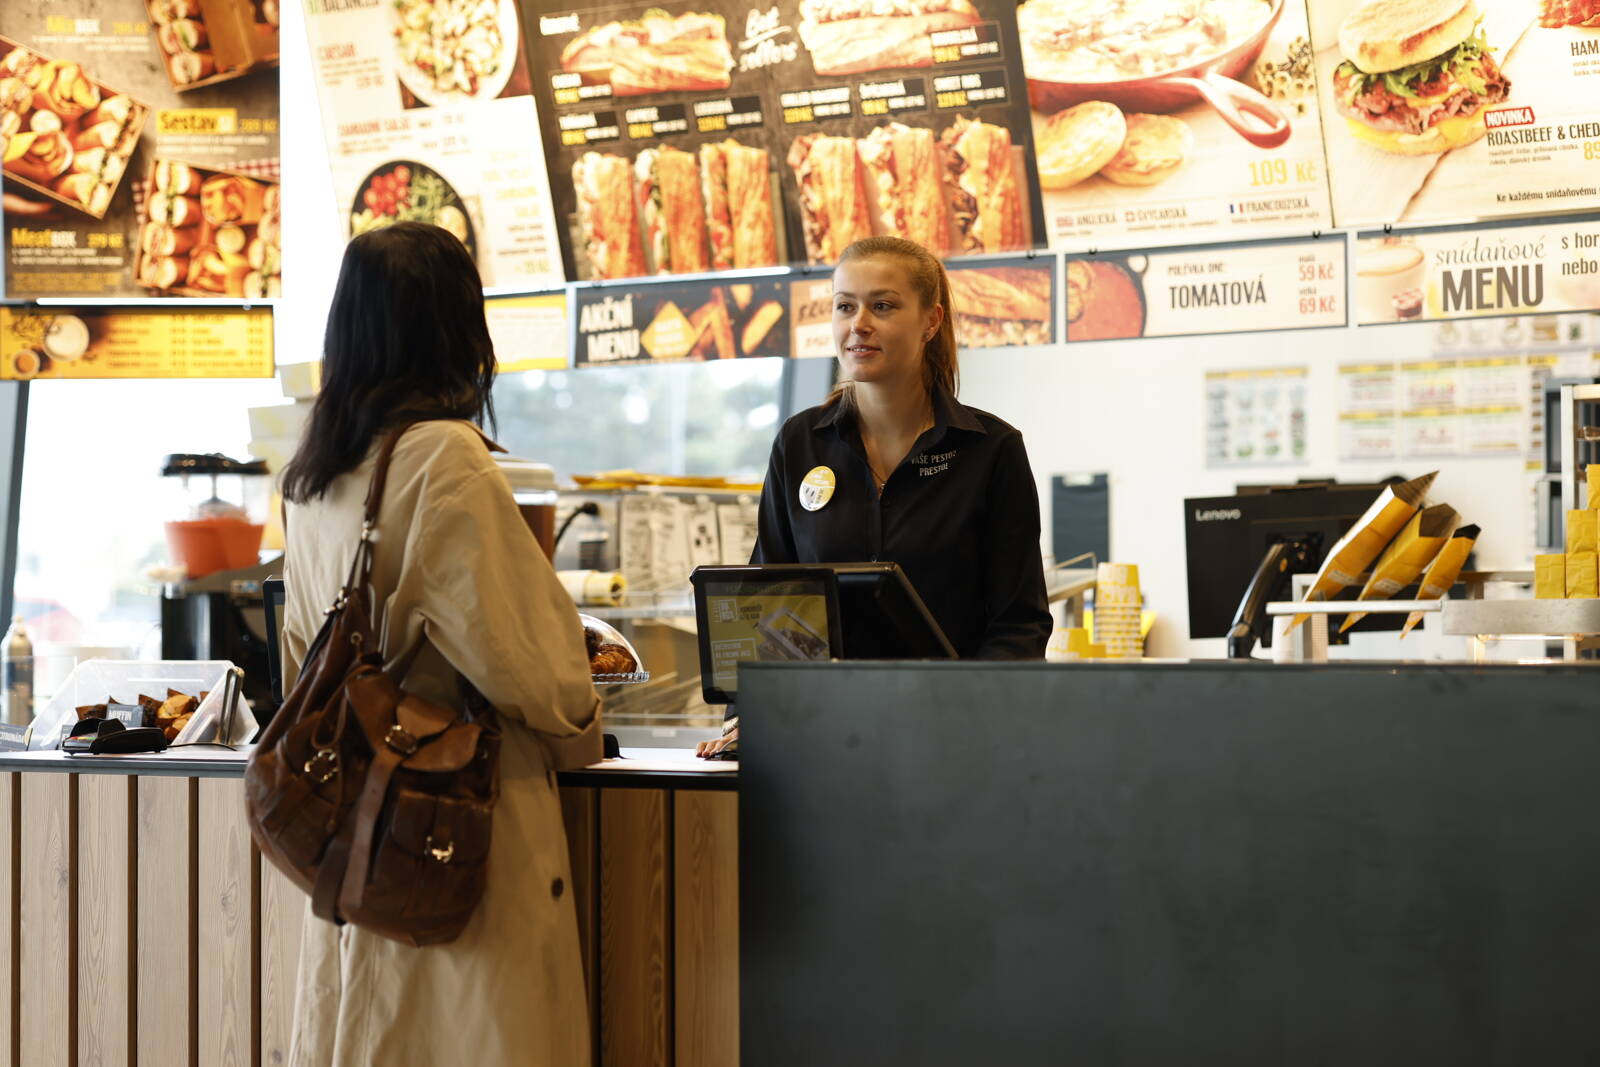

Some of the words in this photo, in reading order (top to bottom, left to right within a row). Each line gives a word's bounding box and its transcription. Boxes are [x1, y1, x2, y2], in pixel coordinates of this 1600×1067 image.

[1570, 39, 1599, 56] HAM
[1486, 109, 1531, 126] NOVINKA
[1487, 126, 1553, 146] ROASTBEEF
[1557, 125, 1567, 140] &
[1569, 122, 1600, 139] CHED
[1248, 158, 1288, 187] 109
[1496, 194, 1507, 203] Ke
[1509, 191, 1543, 202] každému
[1434, 234, 1546, 267] snídaňové
[1561, 235, 1569, 250] s
[1299, 264, 1315, 281] 59
[1562, 258, 1598, 276] nebo
[1169, 273, 1267, 310] TOMATOVÁ
[1442, 264, 1544, 312] MENU
[579, 293, 633, 333] AKČNÍ
[1299, 297, 1316, 314] 69
[586, 328, 640, 362] MENU
[1195, 509, 1241, 521] Lenovo
